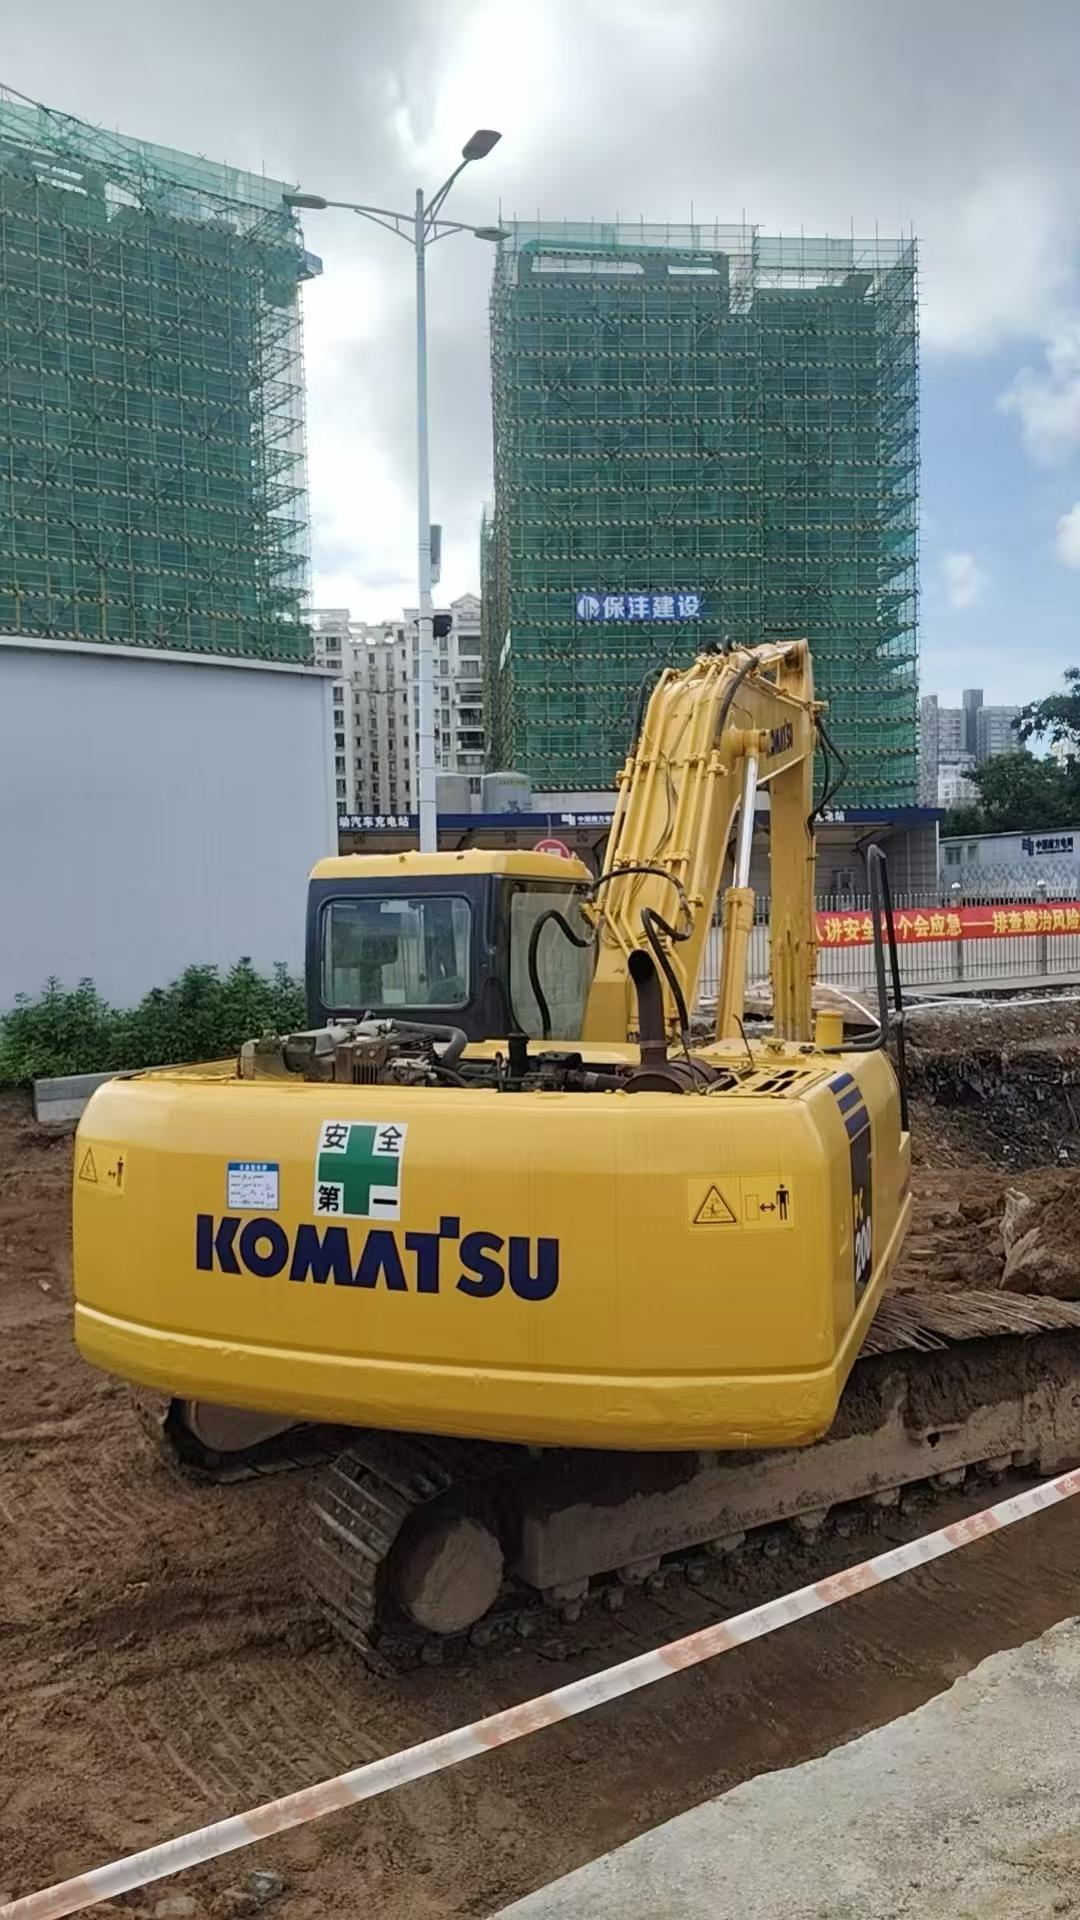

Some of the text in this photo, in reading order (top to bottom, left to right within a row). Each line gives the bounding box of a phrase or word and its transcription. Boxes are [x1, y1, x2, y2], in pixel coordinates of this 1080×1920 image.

[339, 815, 409, 828] 动汽车充电站
[322, 1123, 402, 1153] 安全
[318, 1184, 398, 1212] 第一
[196, 1213, 559, 1301] KOMATSU
